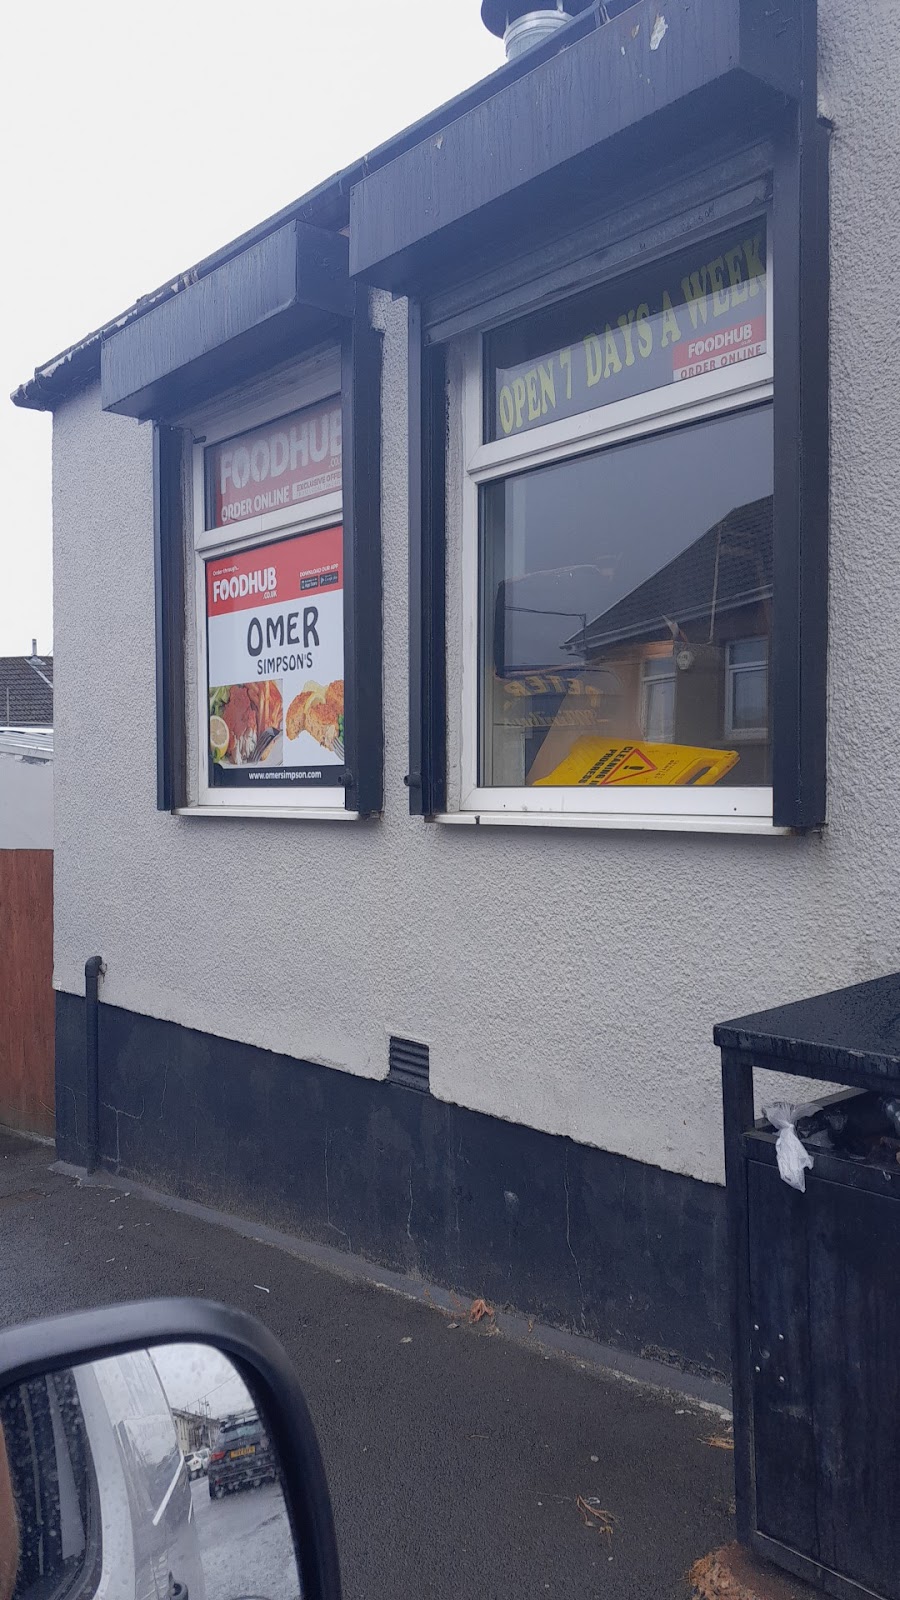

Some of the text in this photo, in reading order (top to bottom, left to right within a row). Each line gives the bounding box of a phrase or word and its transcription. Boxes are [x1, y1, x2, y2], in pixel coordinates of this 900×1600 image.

[499, 235, 767, 434] OPEN 7 DAYS A WEEK
[688, 324, 753, 358] FOODHUB
[680, 344, 762, 379] ORDER ONLINE
[220, 408, 342, 494] FOODHUB
[296, 475, 326, 492] EXCLUSIVE
[221, 498, 253, 522] ORDER
[253, 485, 290, 512] ONLINE
[213, 566, 277, 603] FOODHUB
[300, 568, 321, 577] DOWNLOAD
[247, 606, 320, 657] OMER
[257, 652, 313, 675] SIMPSON'S
[248, 769, 322, 781] www.omersimpson.com
[578, 749, 618, 783] PROGRESS
[595, 746, 634, 778] CLEANING
